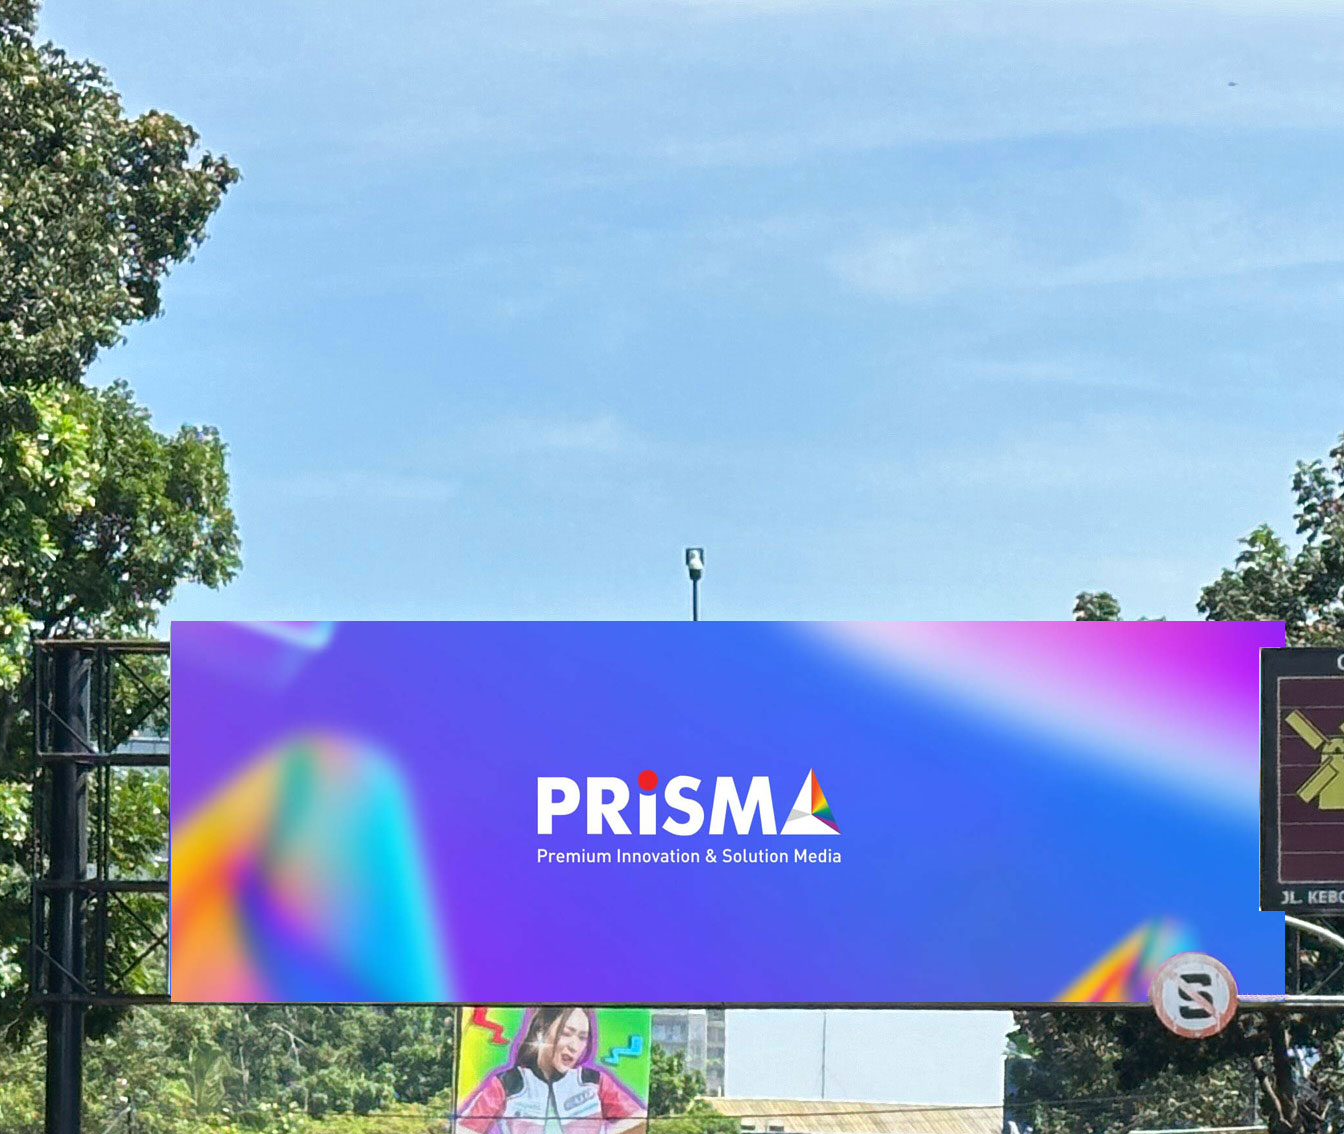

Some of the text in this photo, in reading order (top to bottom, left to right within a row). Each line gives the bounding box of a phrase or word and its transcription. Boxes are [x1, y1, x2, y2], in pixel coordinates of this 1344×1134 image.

[537, 848, 842, 864] Premium Innovation & Solution Media
